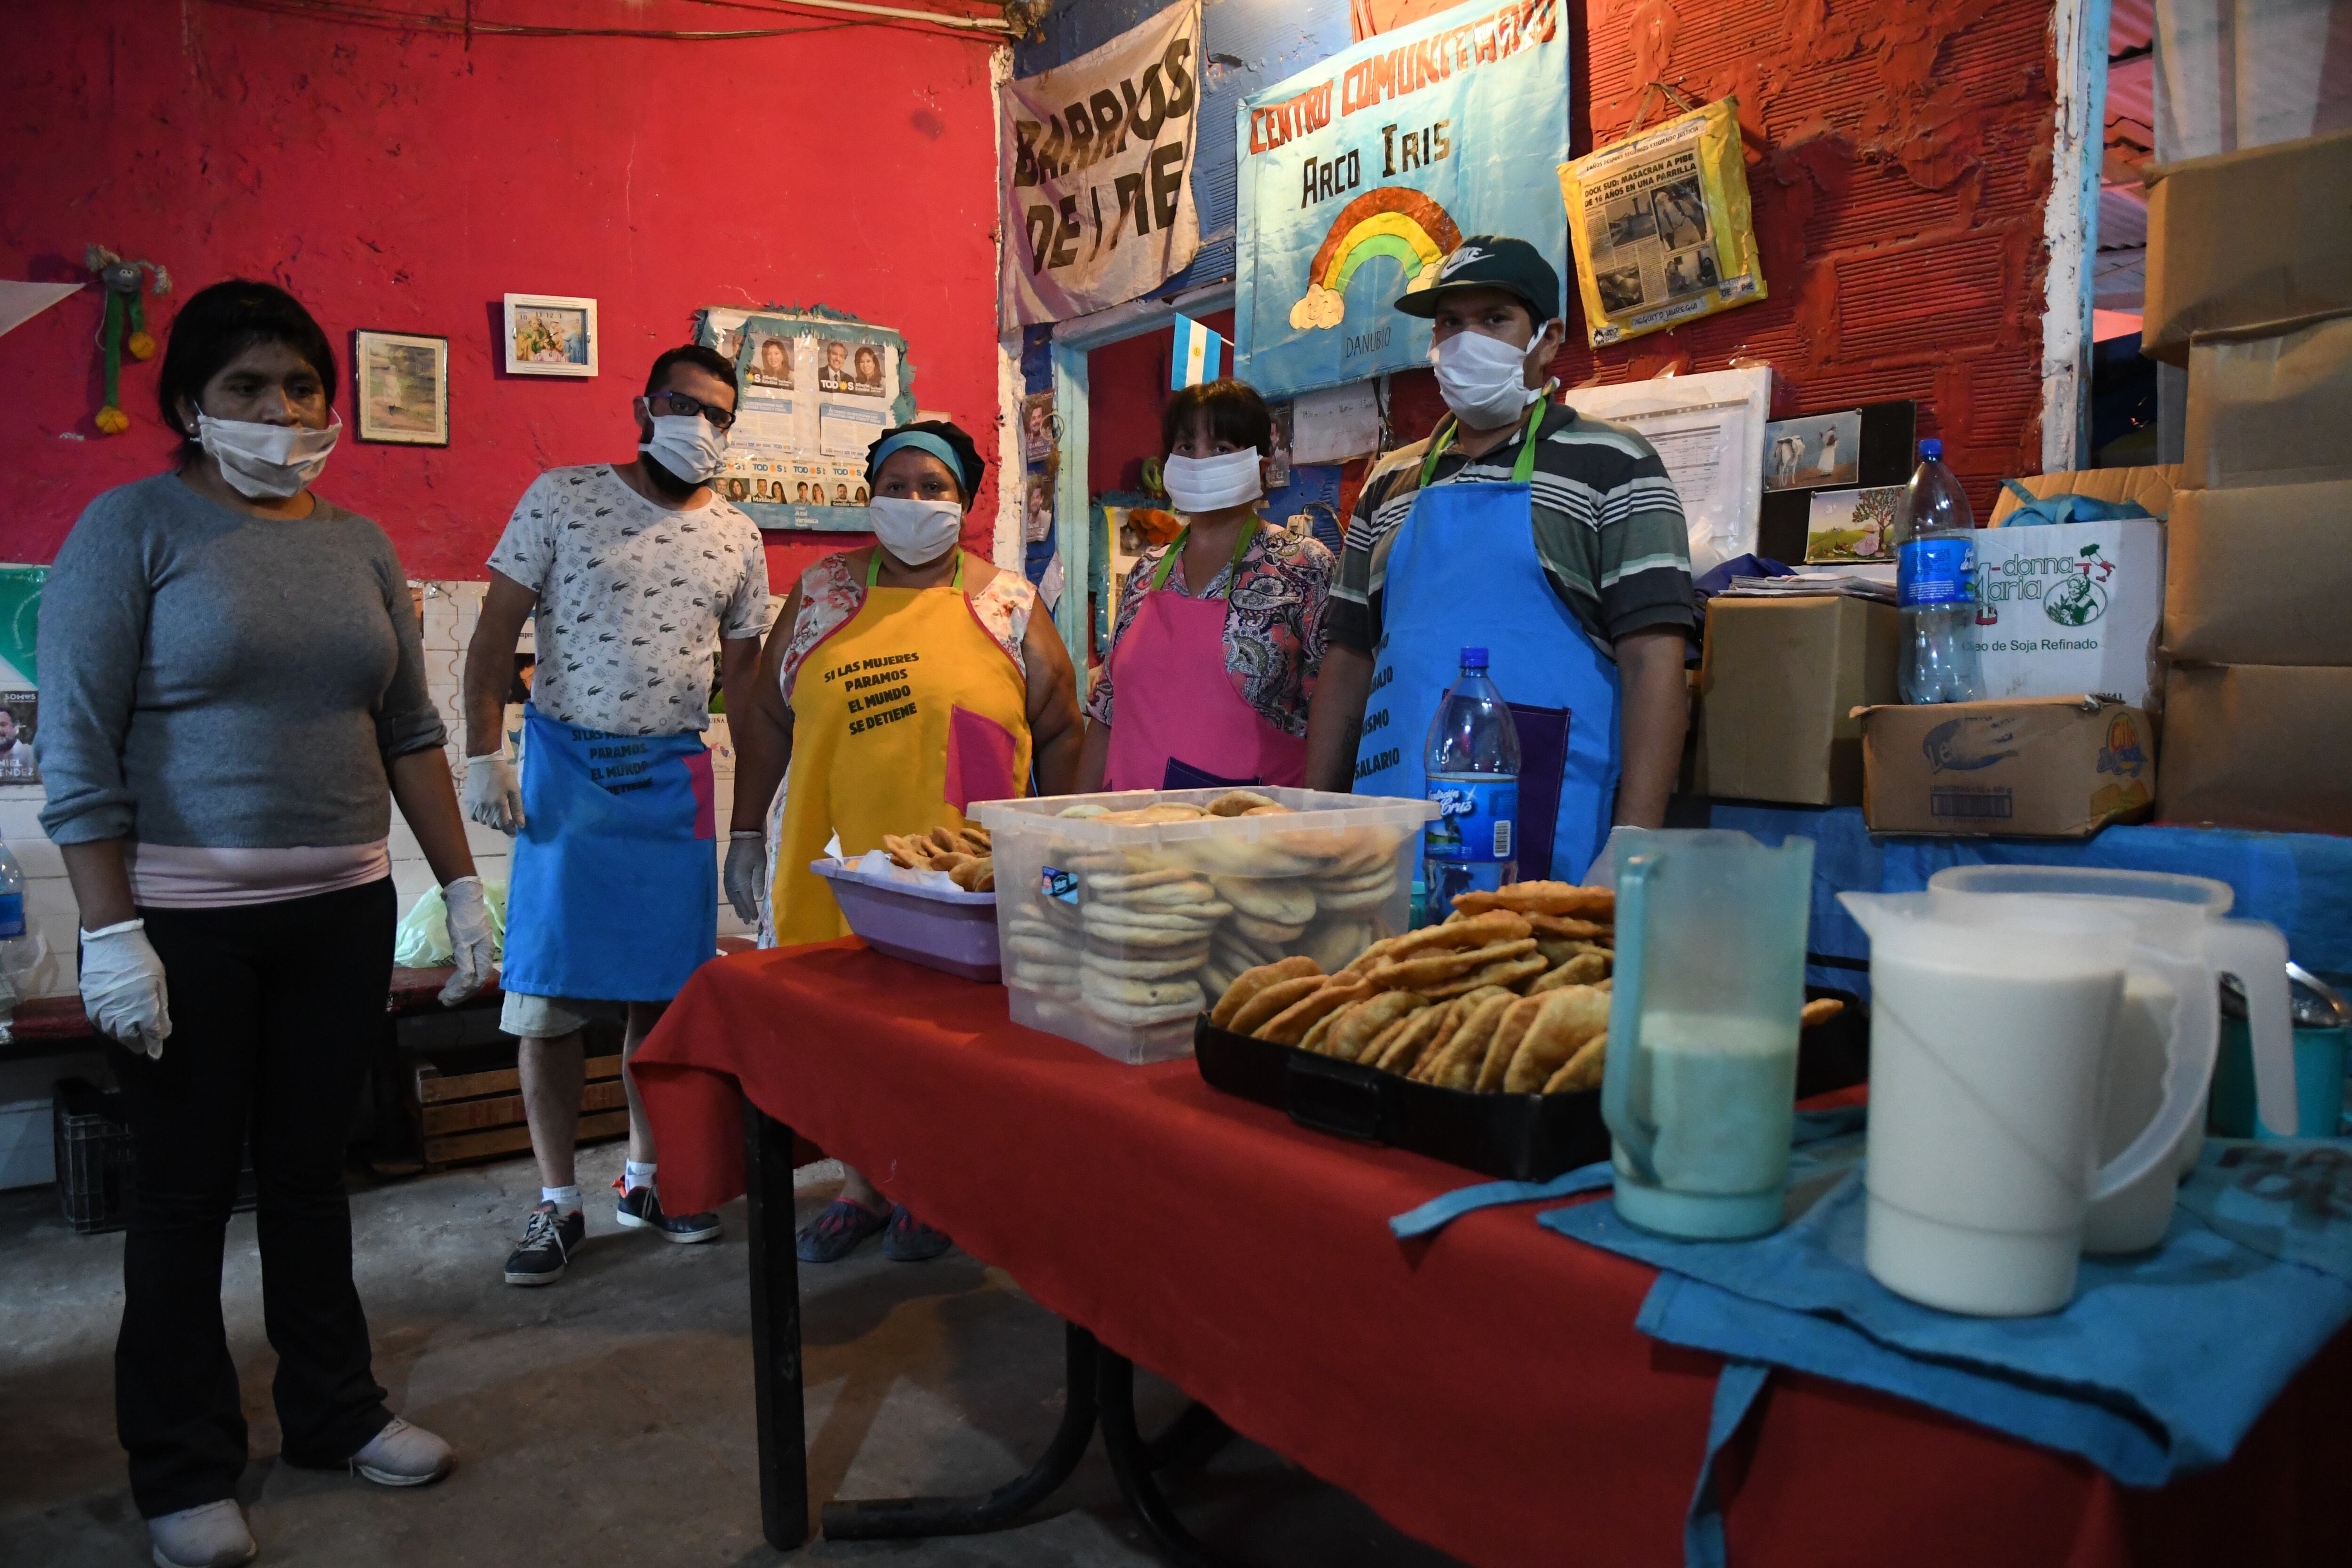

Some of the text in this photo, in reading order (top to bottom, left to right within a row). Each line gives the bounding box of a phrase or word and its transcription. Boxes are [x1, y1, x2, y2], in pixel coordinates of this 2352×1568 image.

[1250, 0, 1557, 155] CENTRO COMUNITARIO
[1015, 38, 1192, 187] BARRIOS
[1625, 145, 1649, 159] SEGUIMOS
[1650, 135, 1676, 150] EXIGIENDO
[1677, 126, 1698, 139] JUSTICIA
[1301, 119, 1450, 209] ARCO IRIS
[1585, 185, 1602, 198] DOCK
[1604, 180, 1619, 191] SUD:
[1621, 164, 1664, 184] MASACRAN
[1667, 160, 1672, 168] A
[1675, 153, 1693, 165] PIBE
[1585, 199, 1593, 207] DE
[1605, 186, 1623, 200] AÑOS
[1626, 183, 1635, 193] EN
[1637, 176, 1654, 188] UNA
[1656, 163, 1696, 182] PARRILLA
[1026, 194, 1081, 276] DE
[1110, 141, 1183, 250] PIE
[1722, 288, 1732, 297] DE
[1741, 283, 1754, 291] PIE
[1346, 326, 1392, 358] DANUBIO
[1992, 640, 2006, 651] de
[2010, 639, 2037, 653] Soja
[2041, 638, 2098, 651] Refinado
[824, 652, 919, 683] SI LAS MUJERES
[844, 669, 908, 692] PARAMOS
[848, 685, 911, 714] EL MUNDO
[849, 702, 917, 735] SE DETIENE
[572, 730, 581, 741] SI
[583, 730, 603, 741] LAS
[590, 742, 647, 759] PARAMOS
[590, 760, 648, 780] EL MUNDO
[1355, 747, 1399, 780] SALARIO
